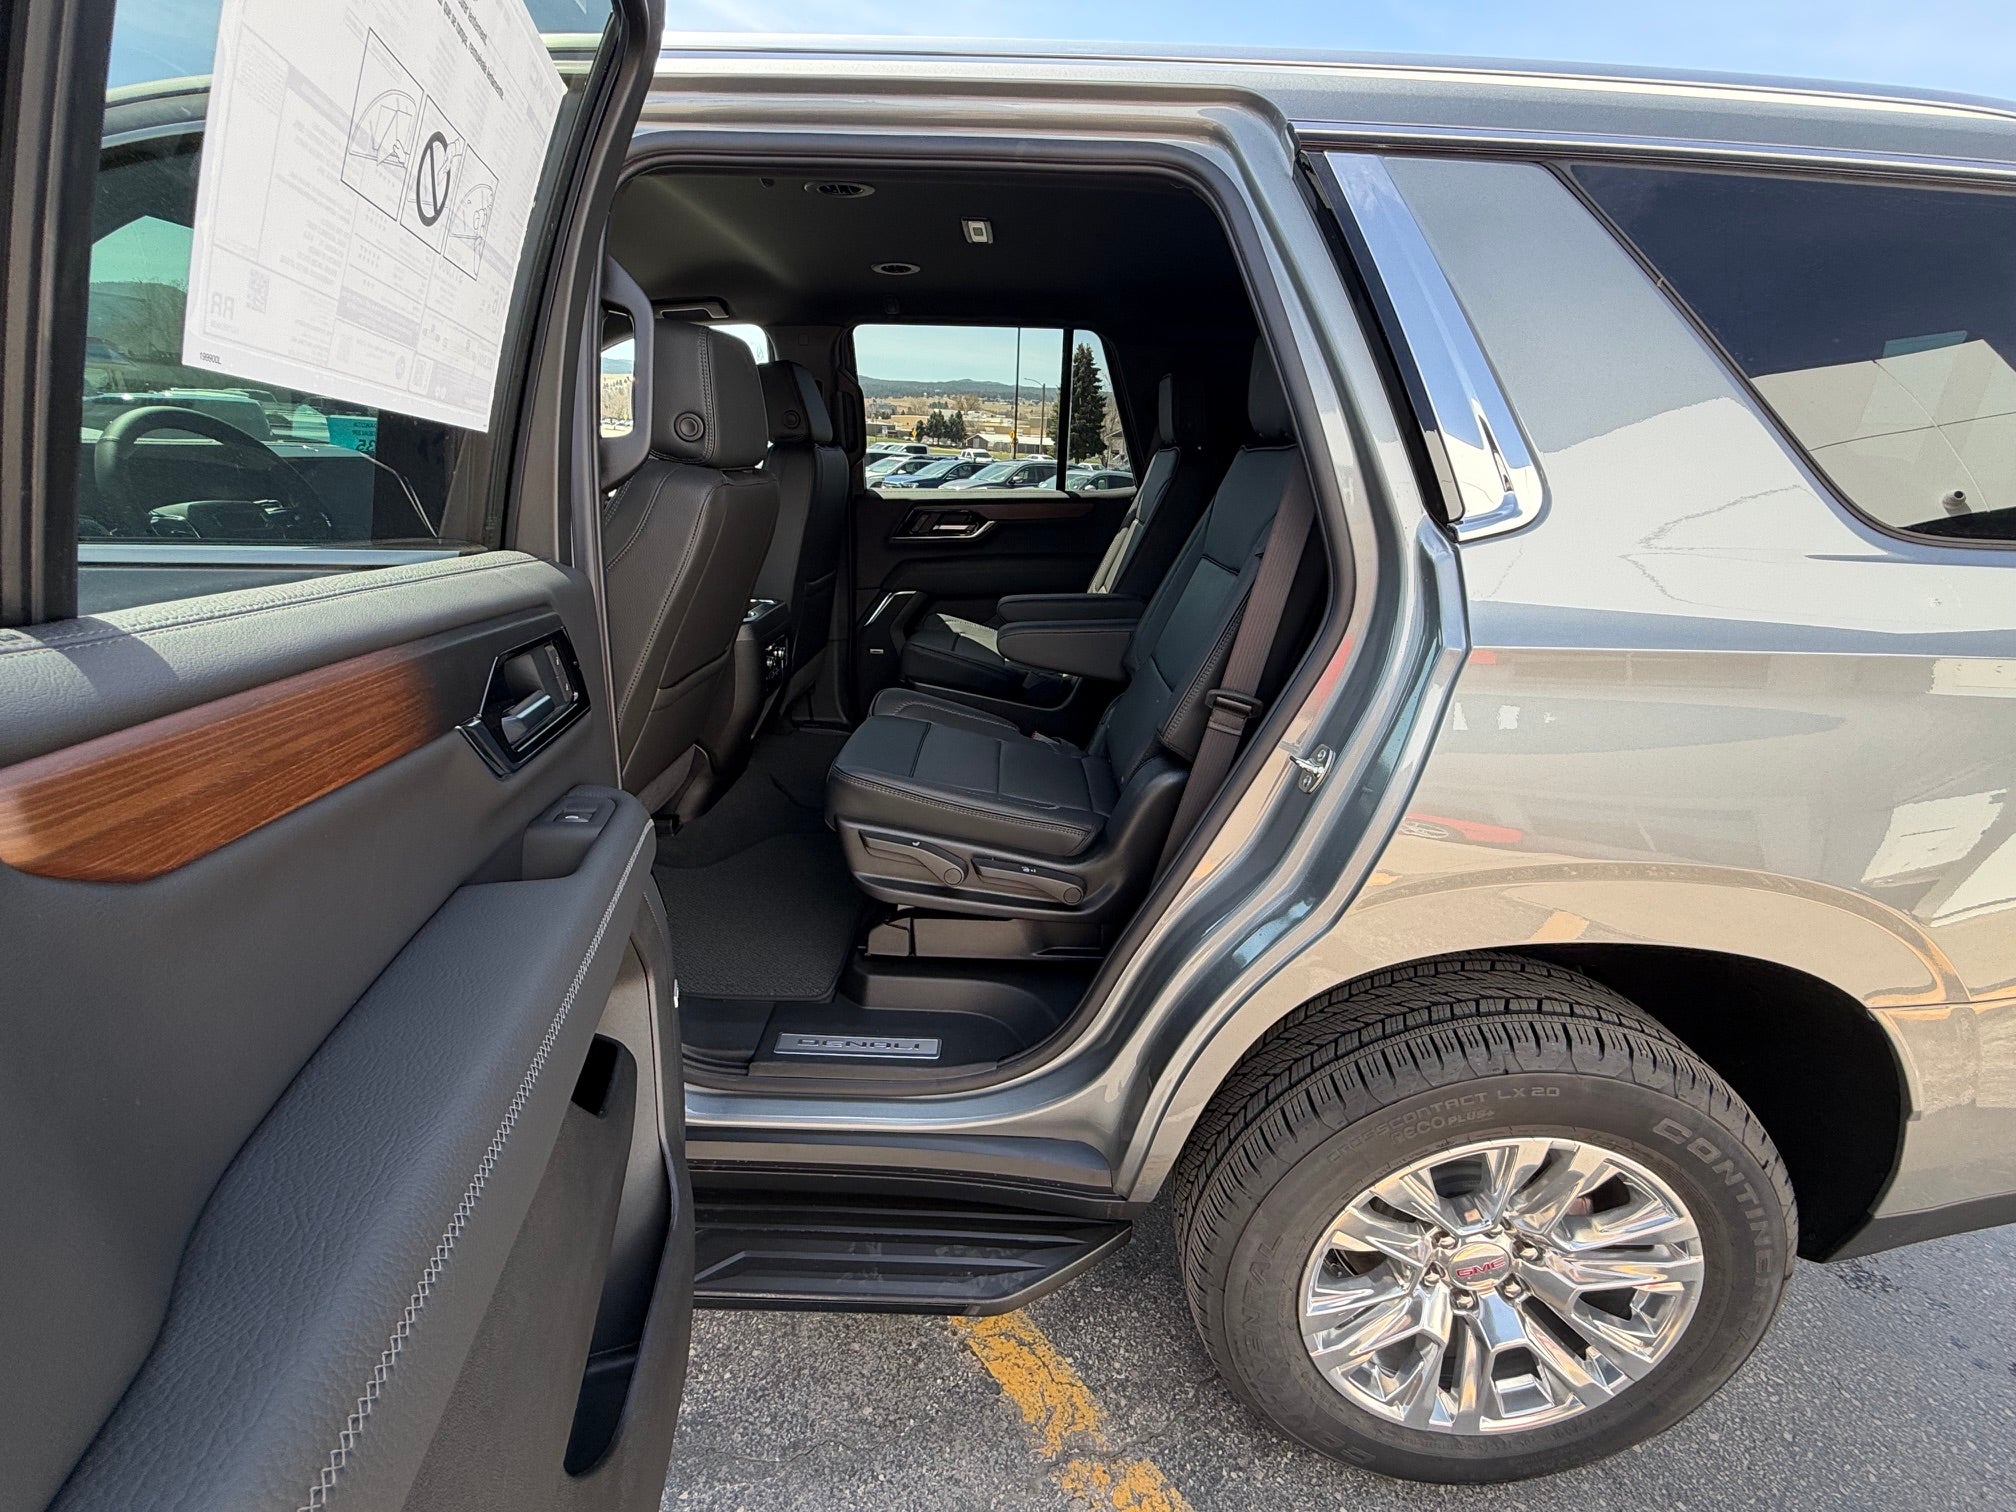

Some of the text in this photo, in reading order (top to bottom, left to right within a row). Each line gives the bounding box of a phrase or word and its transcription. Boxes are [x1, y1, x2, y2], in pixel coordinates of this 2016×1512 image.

[797, 1038, 920, 1051] DENALI
[1497, 1088, 1526, 1100] LX
[1531, 1086, 1561, 1098] 20
[1456, 1256, 1506, 1278] GMC
